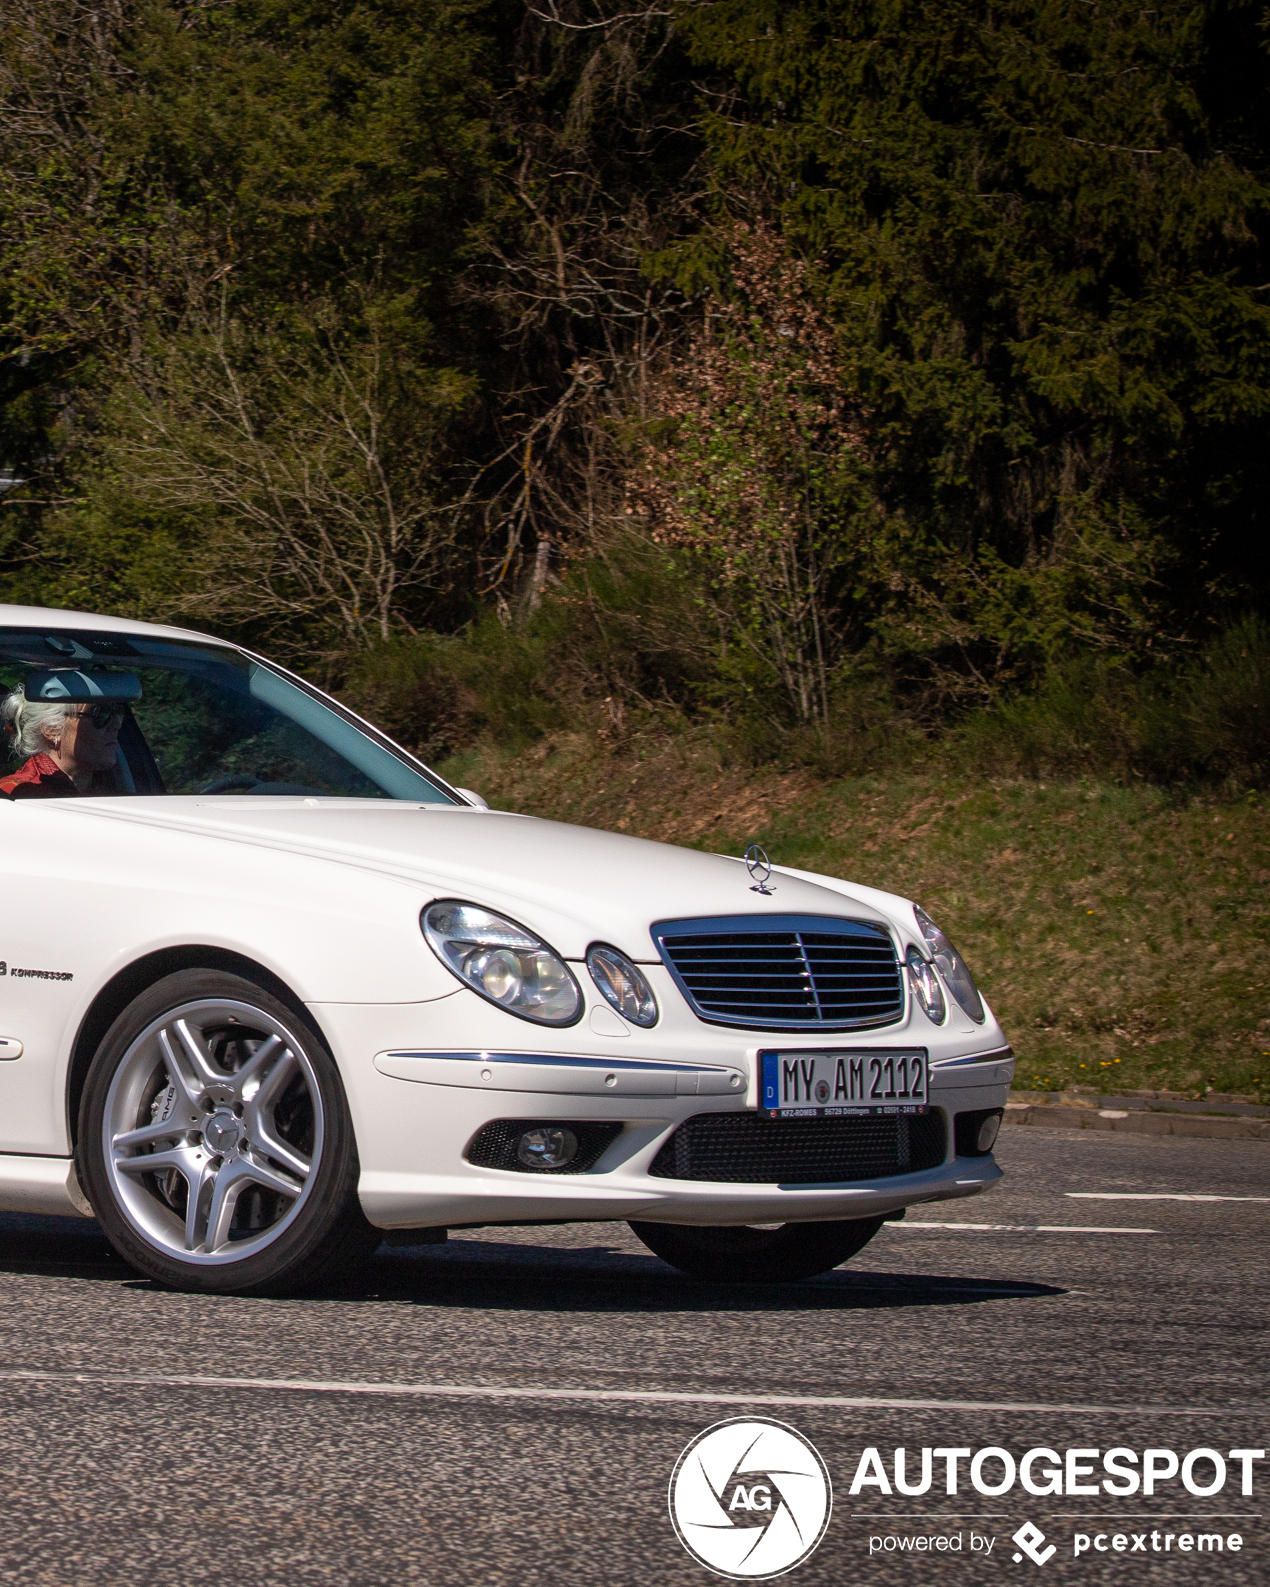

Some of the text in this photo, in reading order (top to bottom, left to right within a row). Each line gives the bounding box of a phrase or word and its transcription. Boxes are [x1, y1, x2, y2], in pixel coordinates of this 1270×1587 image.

[11, 968, 74, 982] KOMPRESSOR
[782, 1056, 924, 1102] MY AM 2112
[162, 1086, 176, 1121] AMG
[767, 1086, 775, 1098] D
